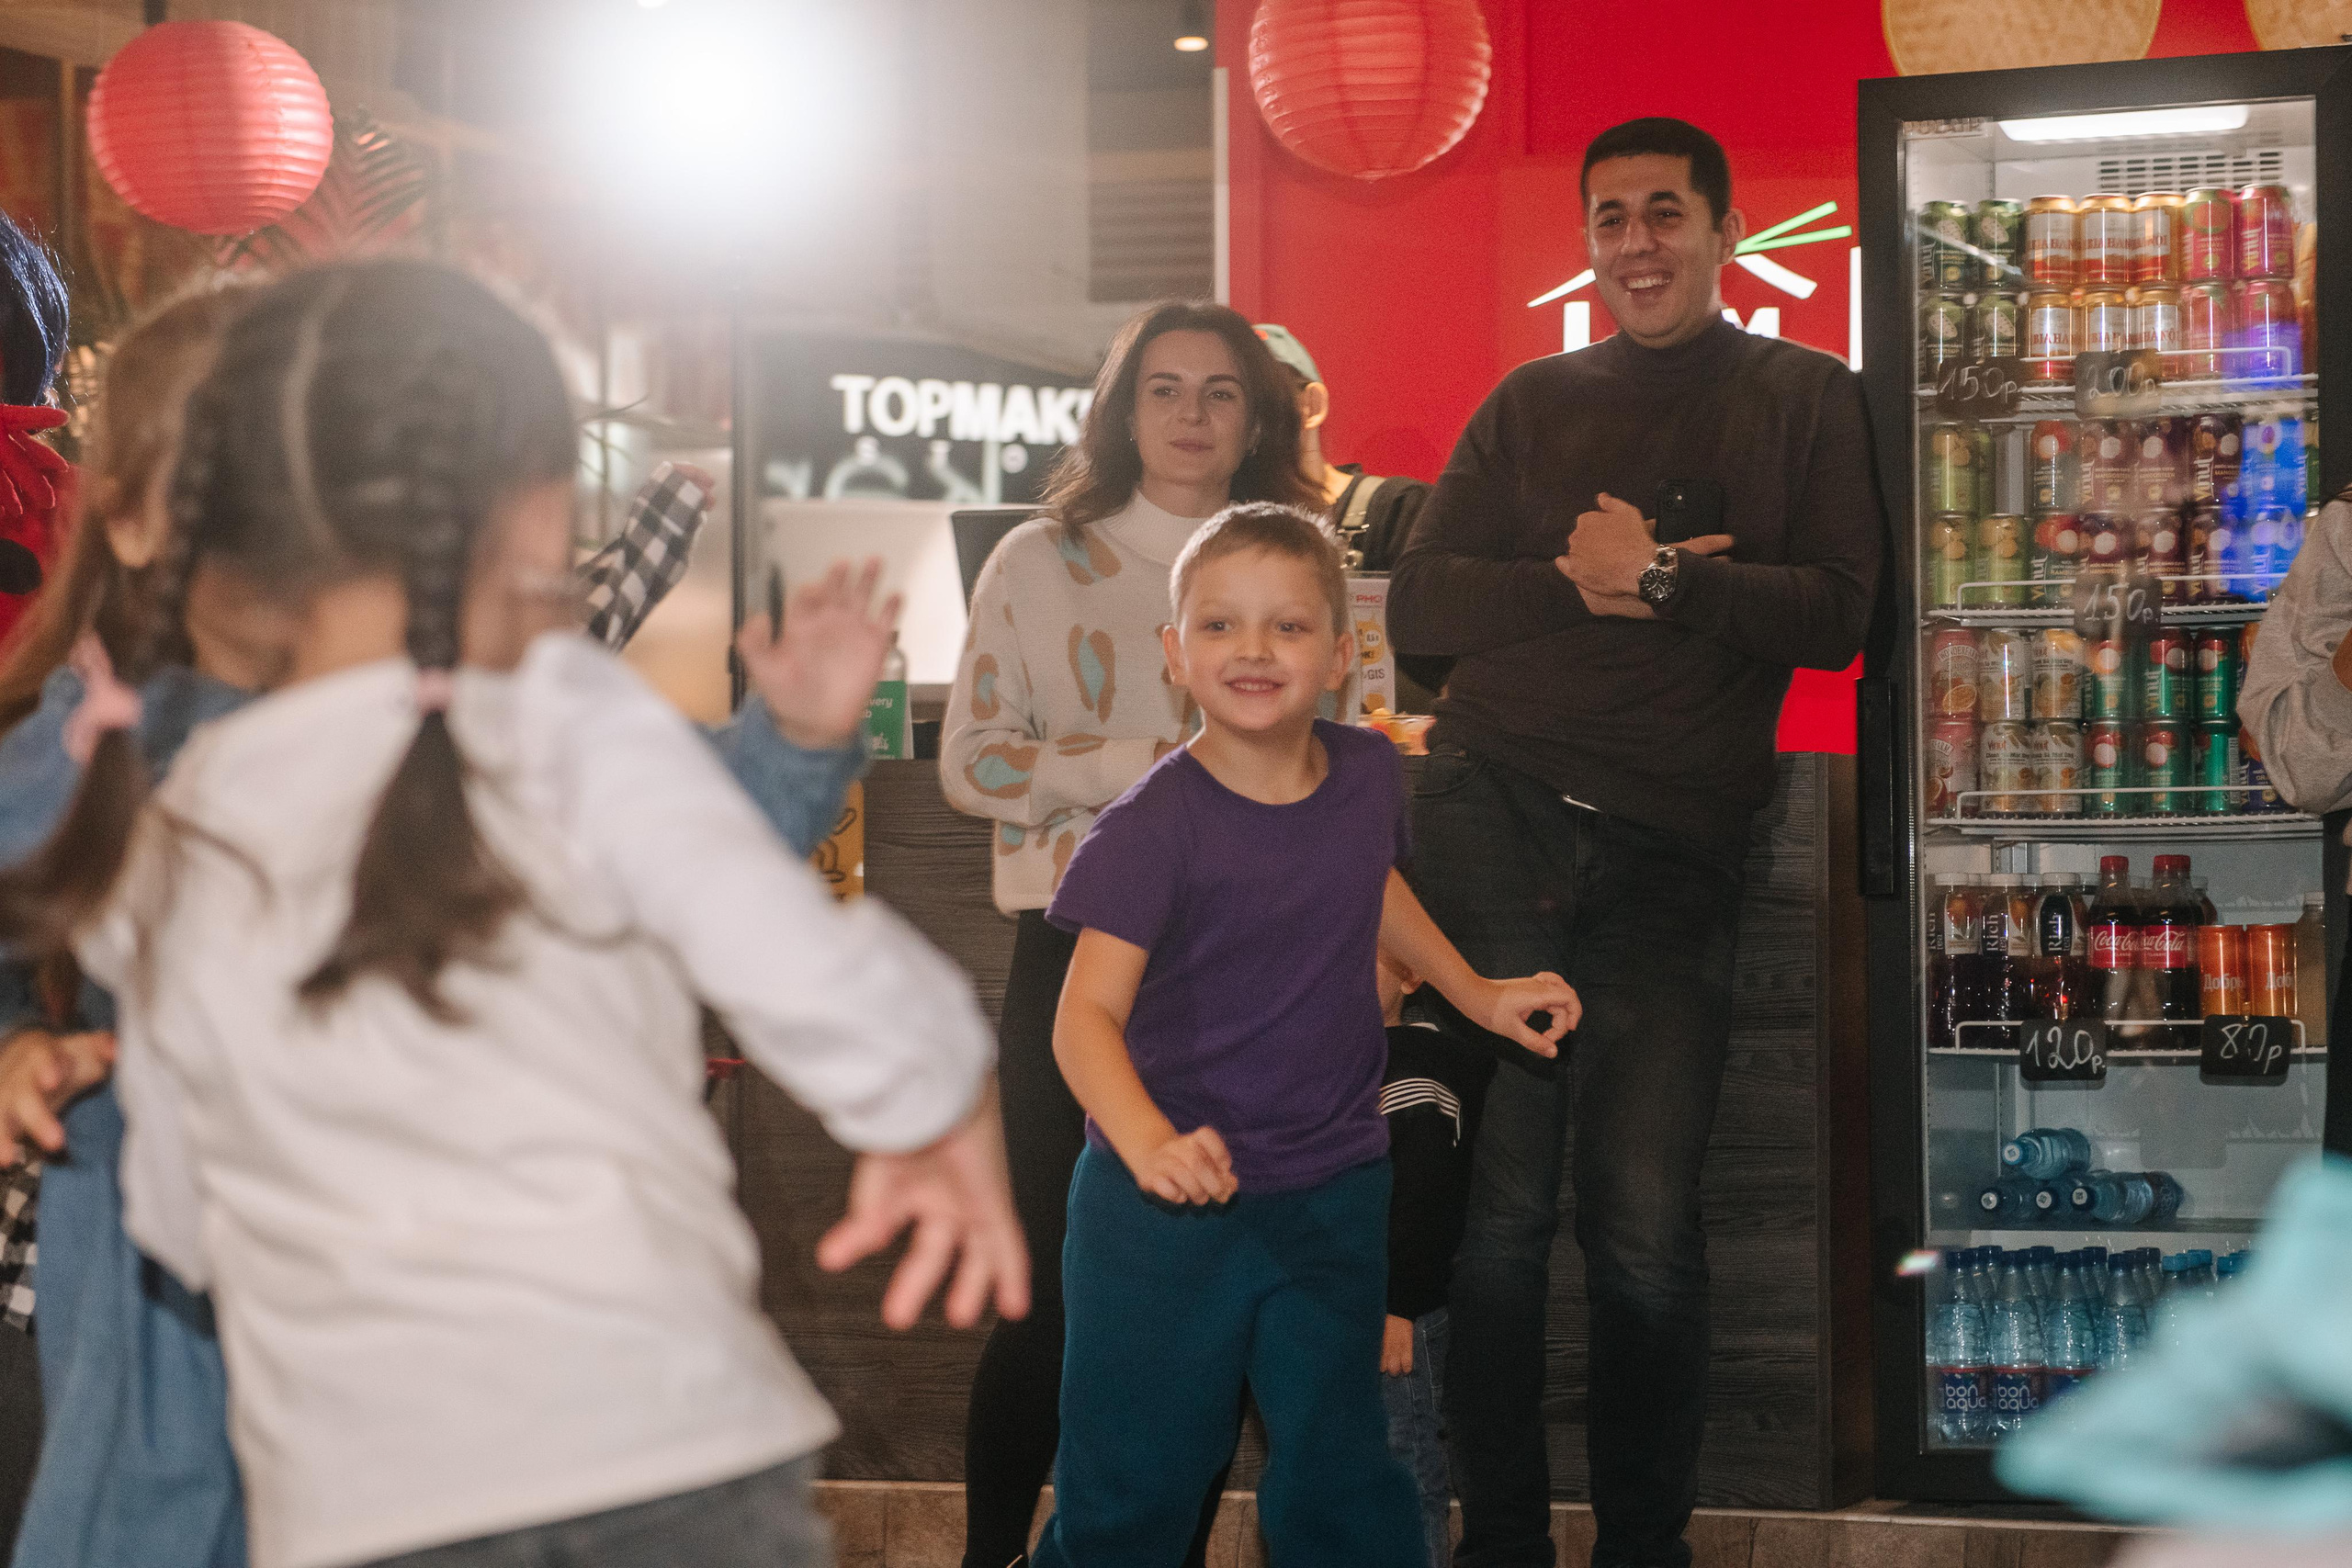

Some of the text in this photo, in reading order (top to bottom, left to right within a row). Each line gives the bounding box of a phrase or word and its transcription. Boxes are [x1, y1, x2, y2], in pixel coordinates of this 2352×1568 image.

[2033, 333, 2052, 344] BIA
[1986, 914, 1999, 952] Rich
[2048, 912, 2063, 952] Rich
[1999, 936, 2007, 952] tea
[2063, 936, 2071, 952] tea
